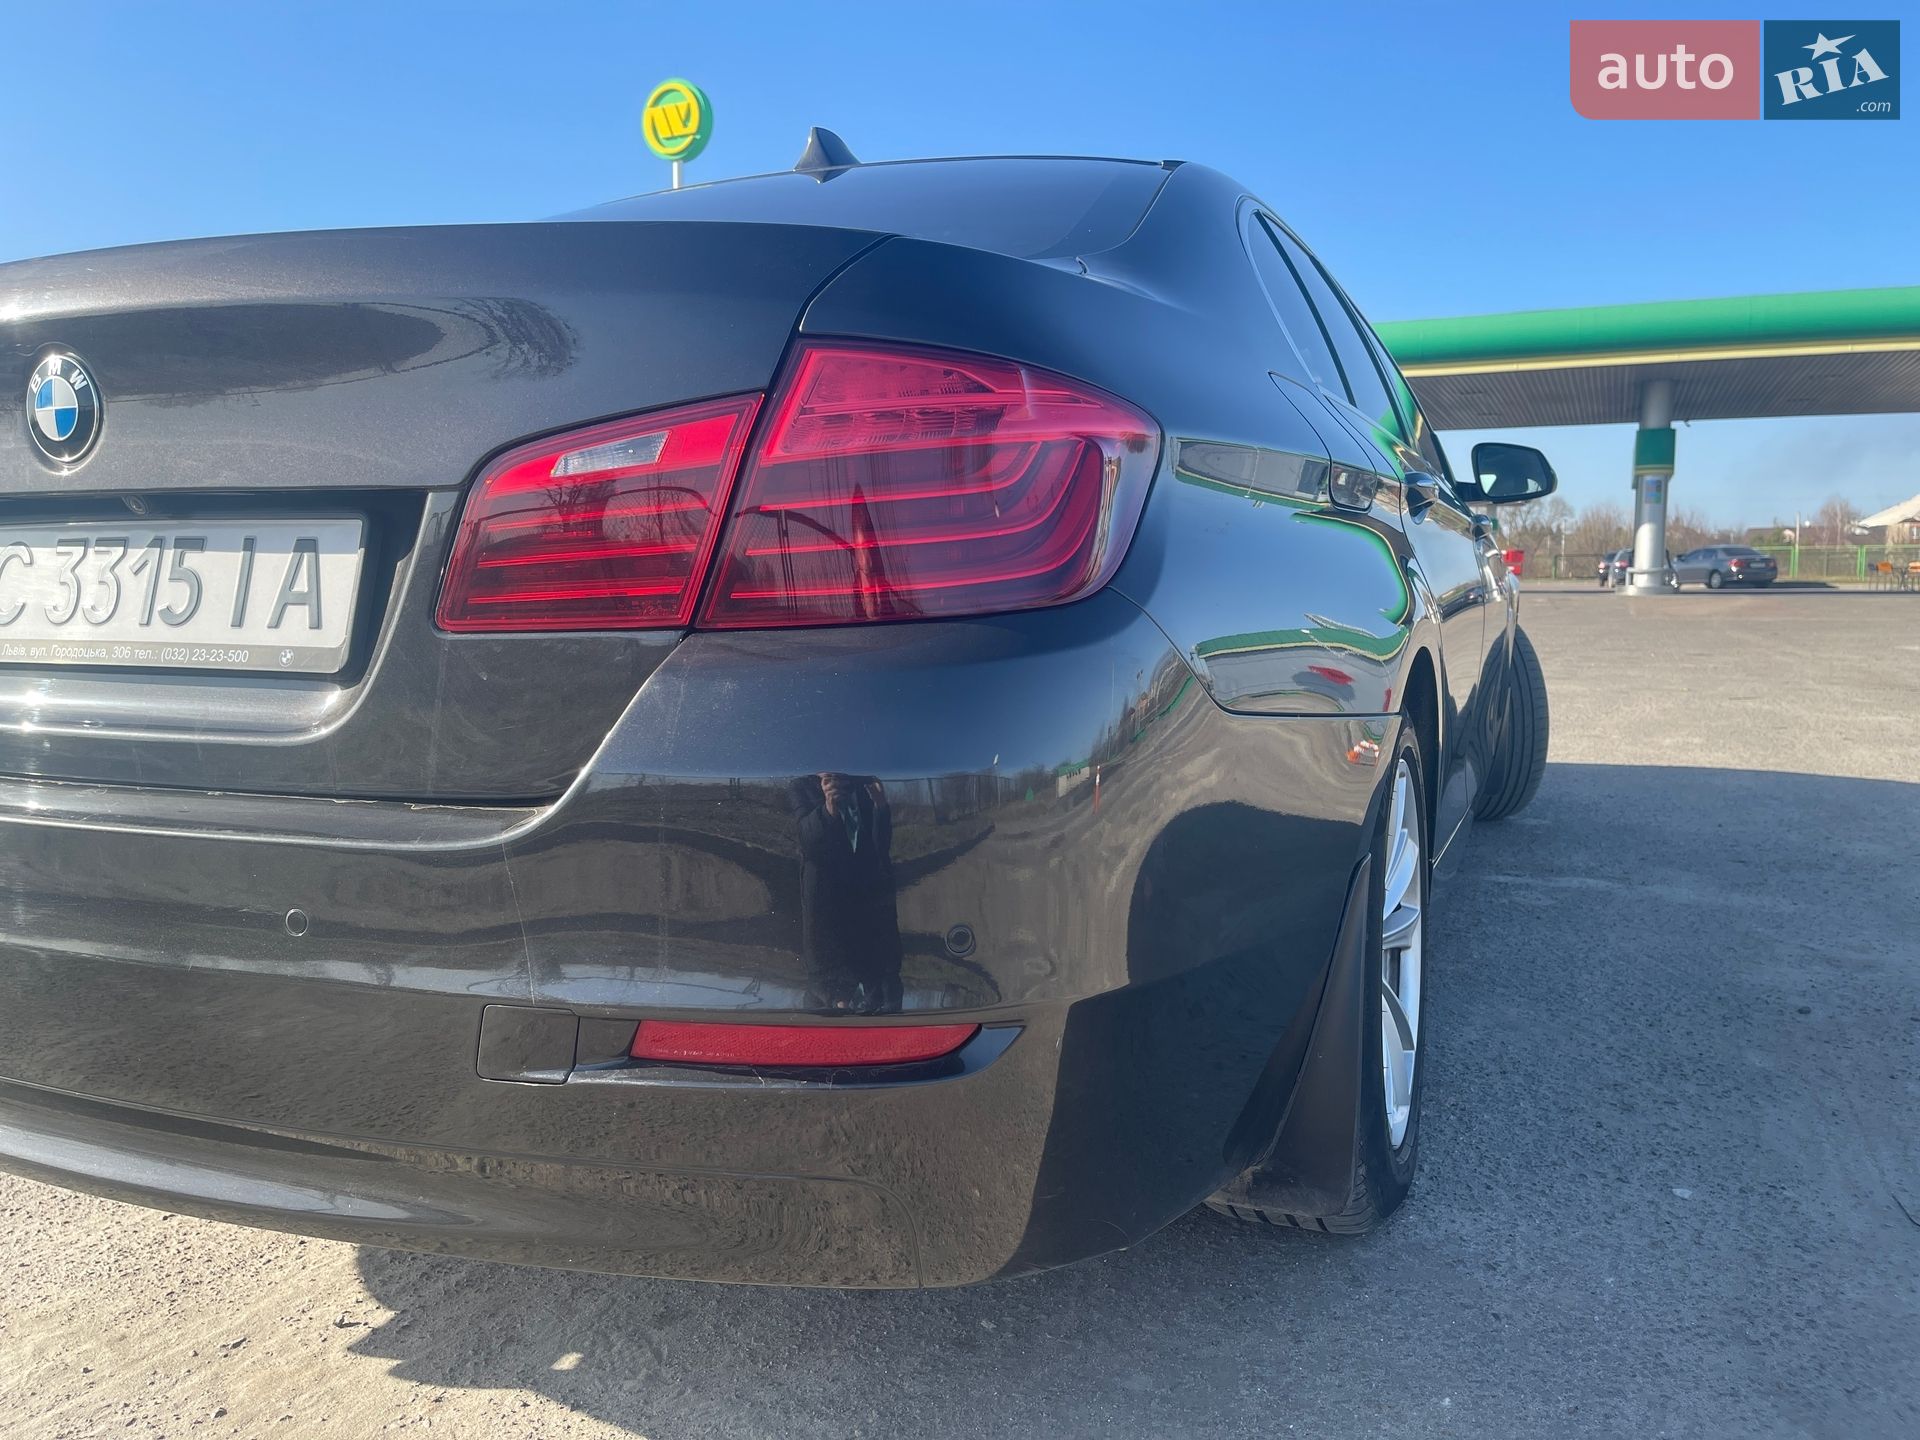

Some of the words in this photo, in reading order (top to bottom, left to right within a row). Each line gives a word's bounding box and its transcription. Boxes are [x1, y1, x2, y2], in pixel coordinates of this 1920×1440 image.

[30, 358, 88, 394] BMW
[44, 536, 208, 627] 3315
[50, 644, 109, 659] Городоцька,
[112, 646, 131, 659] 306
[160, 647, 190, 663] (032)
[192, 648, 249, 663] 23-23-500
